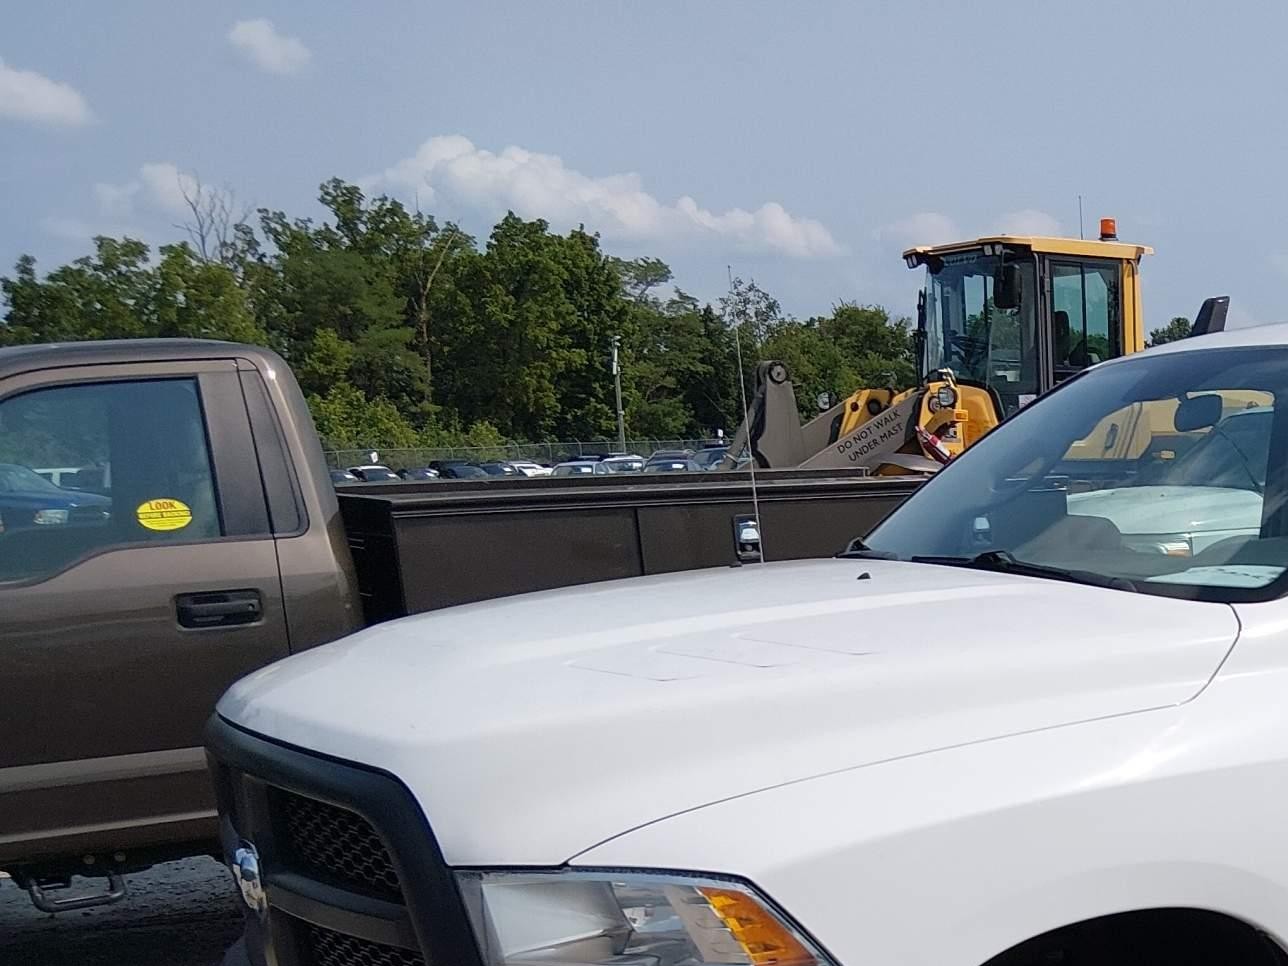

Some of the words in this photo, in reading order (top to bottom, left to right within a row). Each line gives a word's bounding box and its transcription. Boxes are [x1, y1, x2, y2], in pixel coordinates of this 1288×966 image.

[837, 441, 853, 454] DO
[853, 427, 874, 445] NOT
[874, 409, 902, 430] WALK
[848, 439, 880, 462] UNDER
[880, 422, 904, 443] MAST
[149, 501, 177, 511] LOOK
